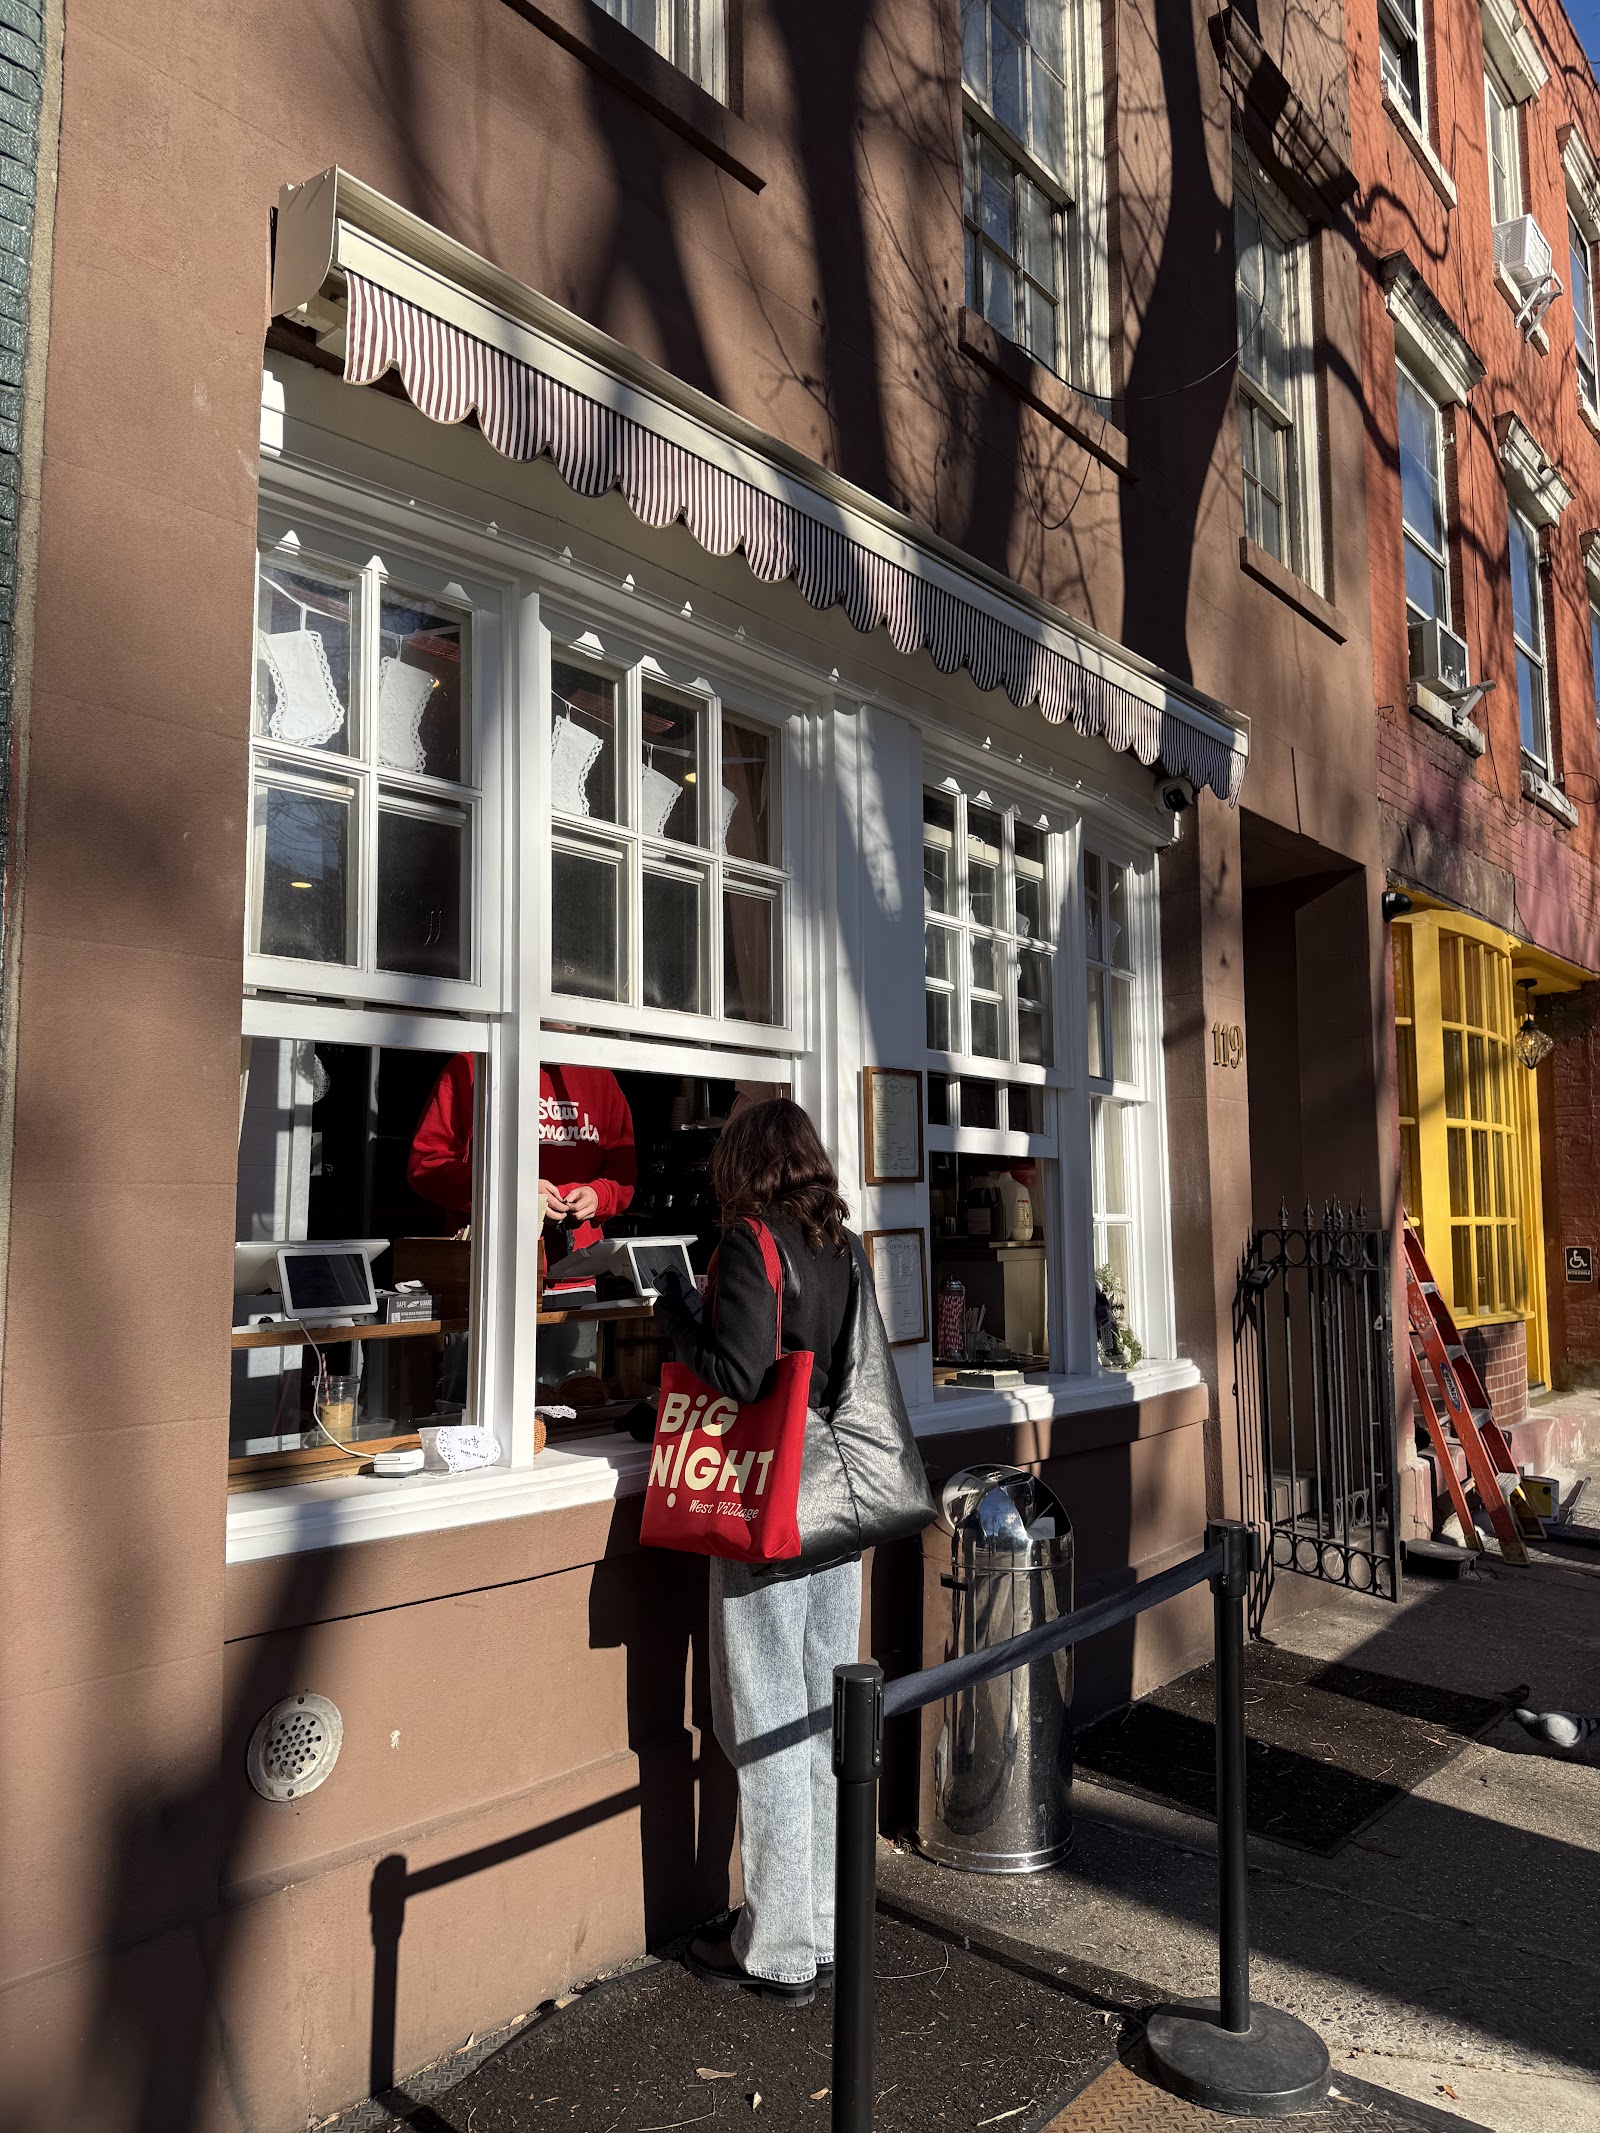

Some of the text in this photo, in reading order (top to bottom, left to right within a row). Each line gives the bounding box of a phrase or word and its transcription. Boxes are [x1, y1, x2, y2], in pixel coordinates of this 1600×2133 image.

[1212, 1022, 1244, 1069] 119
[539, 1096, 579, 1120] Stew
[539, 1113, 600, 1143] onard's
[1444, 1370, 1458, 1402] WERNER
[688, 1500, 760, 1521] West Village
